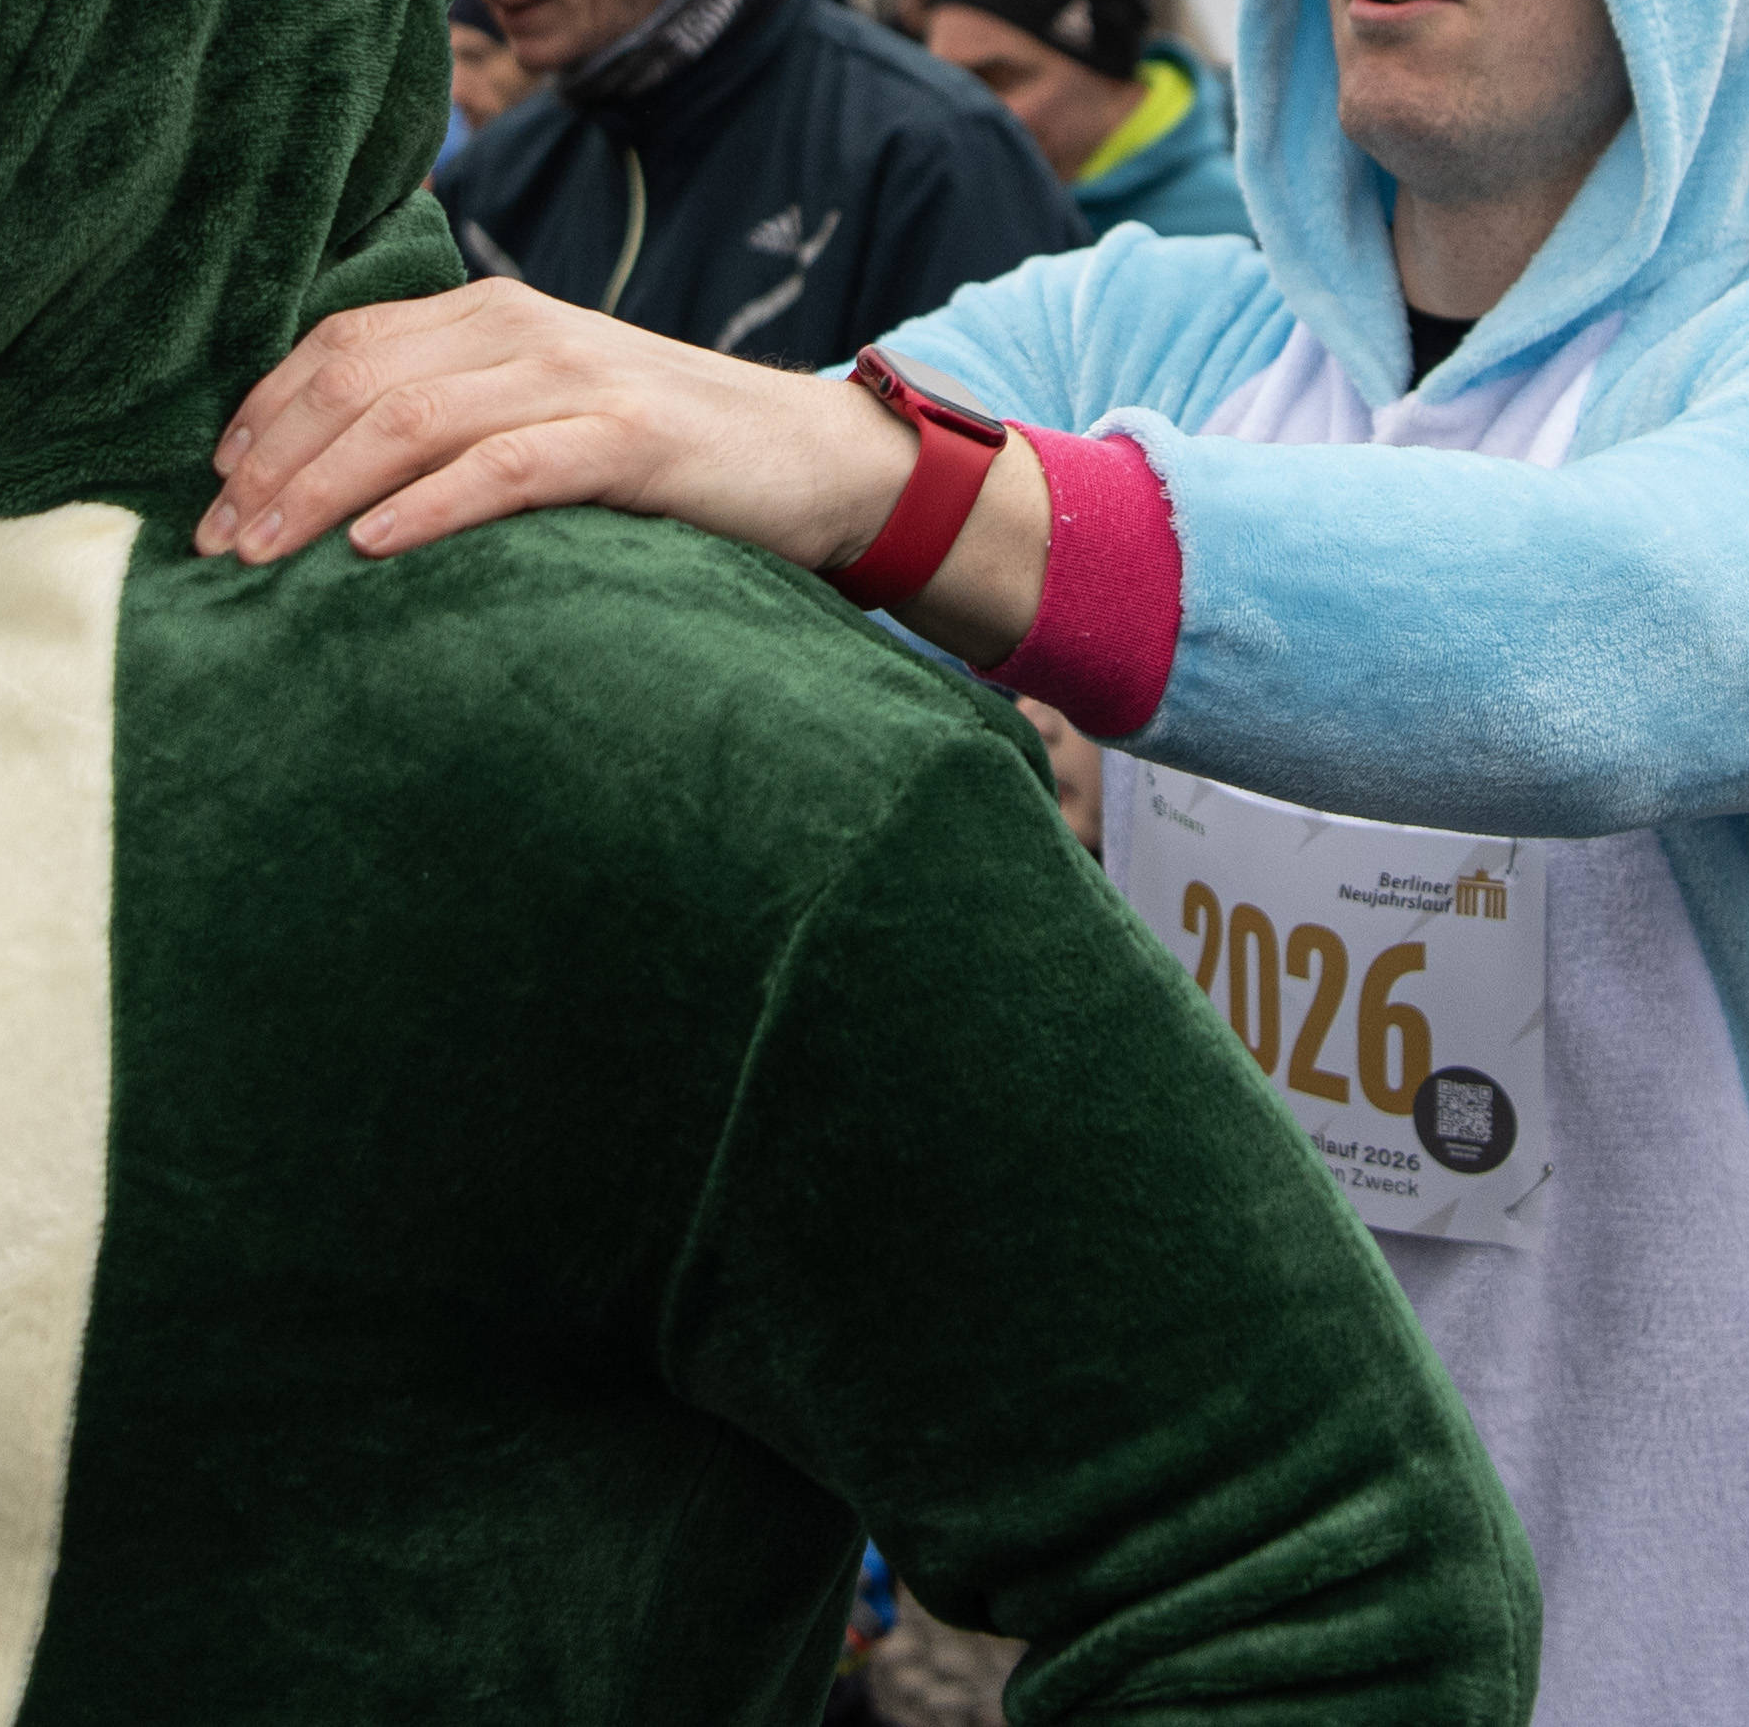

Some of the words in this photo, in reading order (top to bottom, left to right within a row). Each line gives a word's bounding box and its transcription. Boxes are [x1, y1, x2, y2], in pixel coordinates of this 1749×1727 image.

[1338, 883, 1454, 913] Neujahrslauf
[1379, 871, 1453, 895] Berliner
[1181, 879, 1434, 1117] 2026
[1363, 1145, 1421, 1171] 2026
[1351, 1167, 1419, 1198] Zweck
